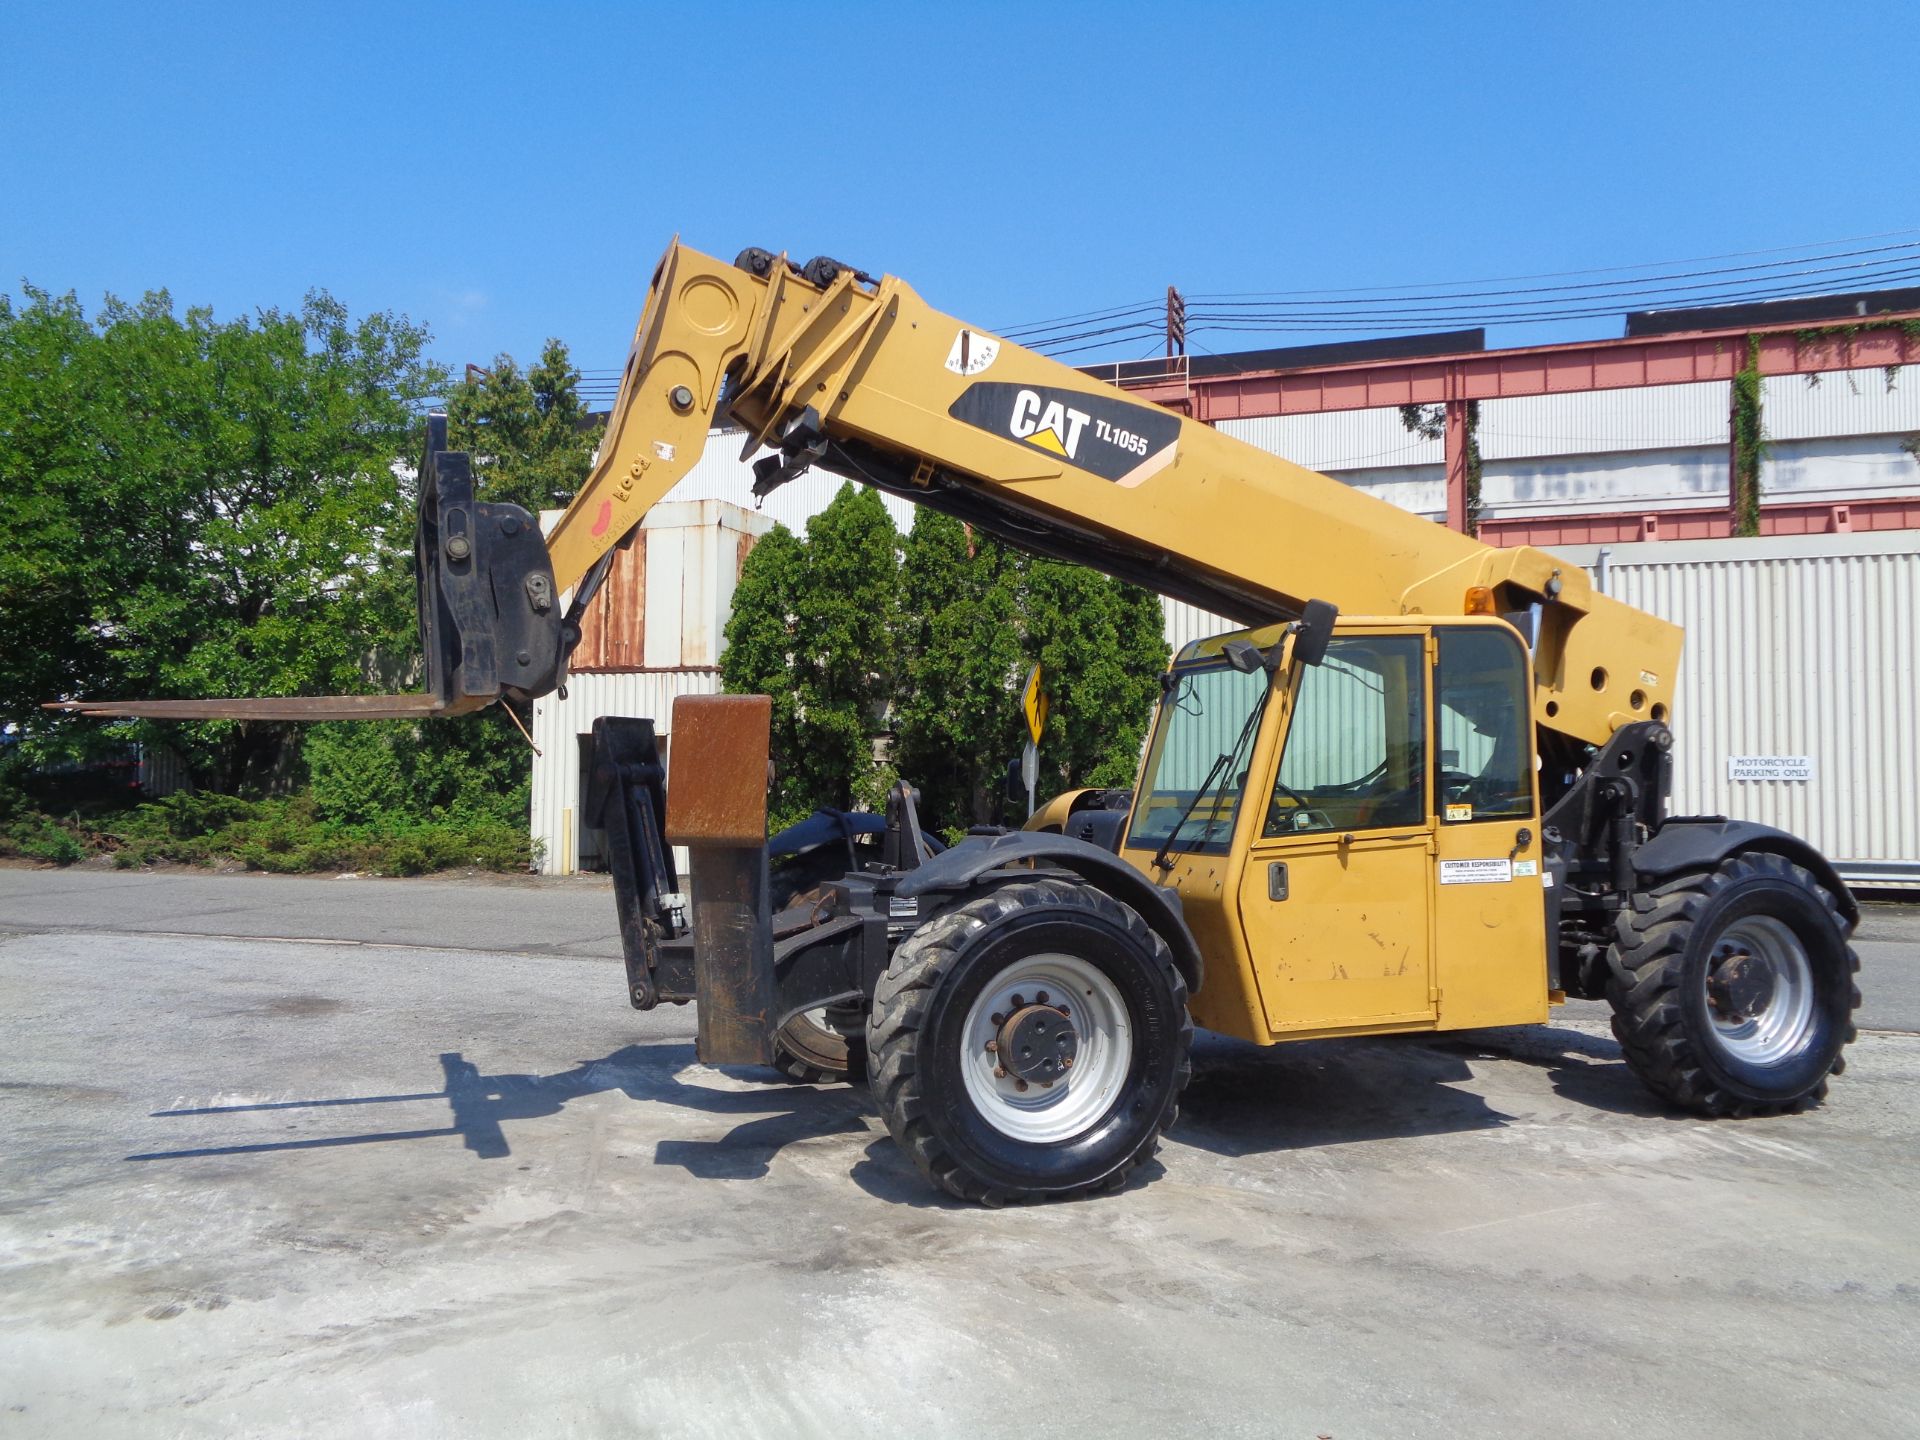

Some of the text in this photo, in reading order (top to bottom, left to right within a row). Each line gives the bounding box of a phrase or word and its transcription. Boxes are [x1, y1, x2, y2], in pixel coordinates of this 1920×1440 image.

[1009, 389, 1149, 460] CAT TL1055
[1736, 758, 1806, 767] MOTORCYCLE
[1734, 768, 1810, 777] PARKING ONLY
